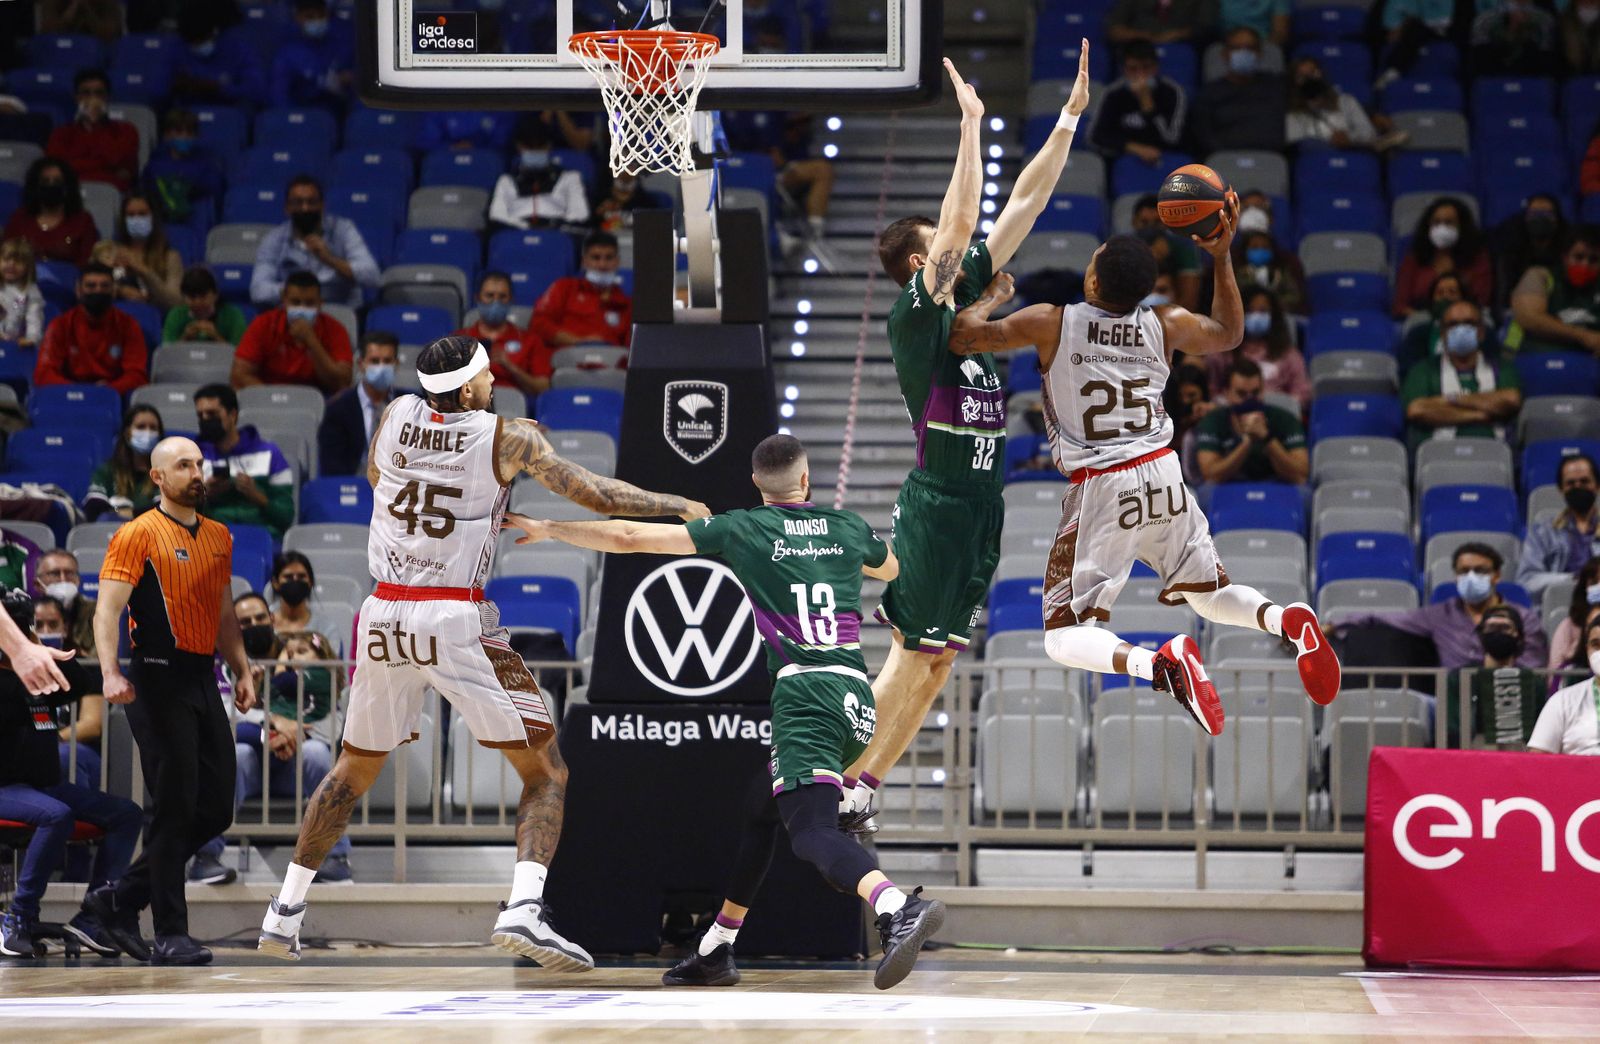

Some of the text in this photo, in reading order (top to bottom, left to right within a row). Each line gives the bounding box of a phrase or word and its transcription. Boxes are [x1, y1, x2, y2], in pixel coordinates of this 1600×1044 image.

[418, 23, 444, 38] liga
[418, 35, 474, 48] endesa
[1087, 321, 1145, 348] McGEE
[1084, 355, 1118, 364] GRUPO
[1080, 378, 1152, 441] 25
[398, 422, 468, 454] GAMBLE
[677, 420, 713, 432] Unicaja
[435, 464, 466, 472] HEREDA
[972, 437, 995, 471] 32
[387, 480, 463, 540] 45
[1118, 481, 1188, 530] atu
[783, 518, 828, 536] ALONSO
[405, 554, 448, 572] Recoletas
[790, 582, 838, 645] 13
[367, 620, 438, 666] atu
[591, 713, 772, 747] Málaga Wag
